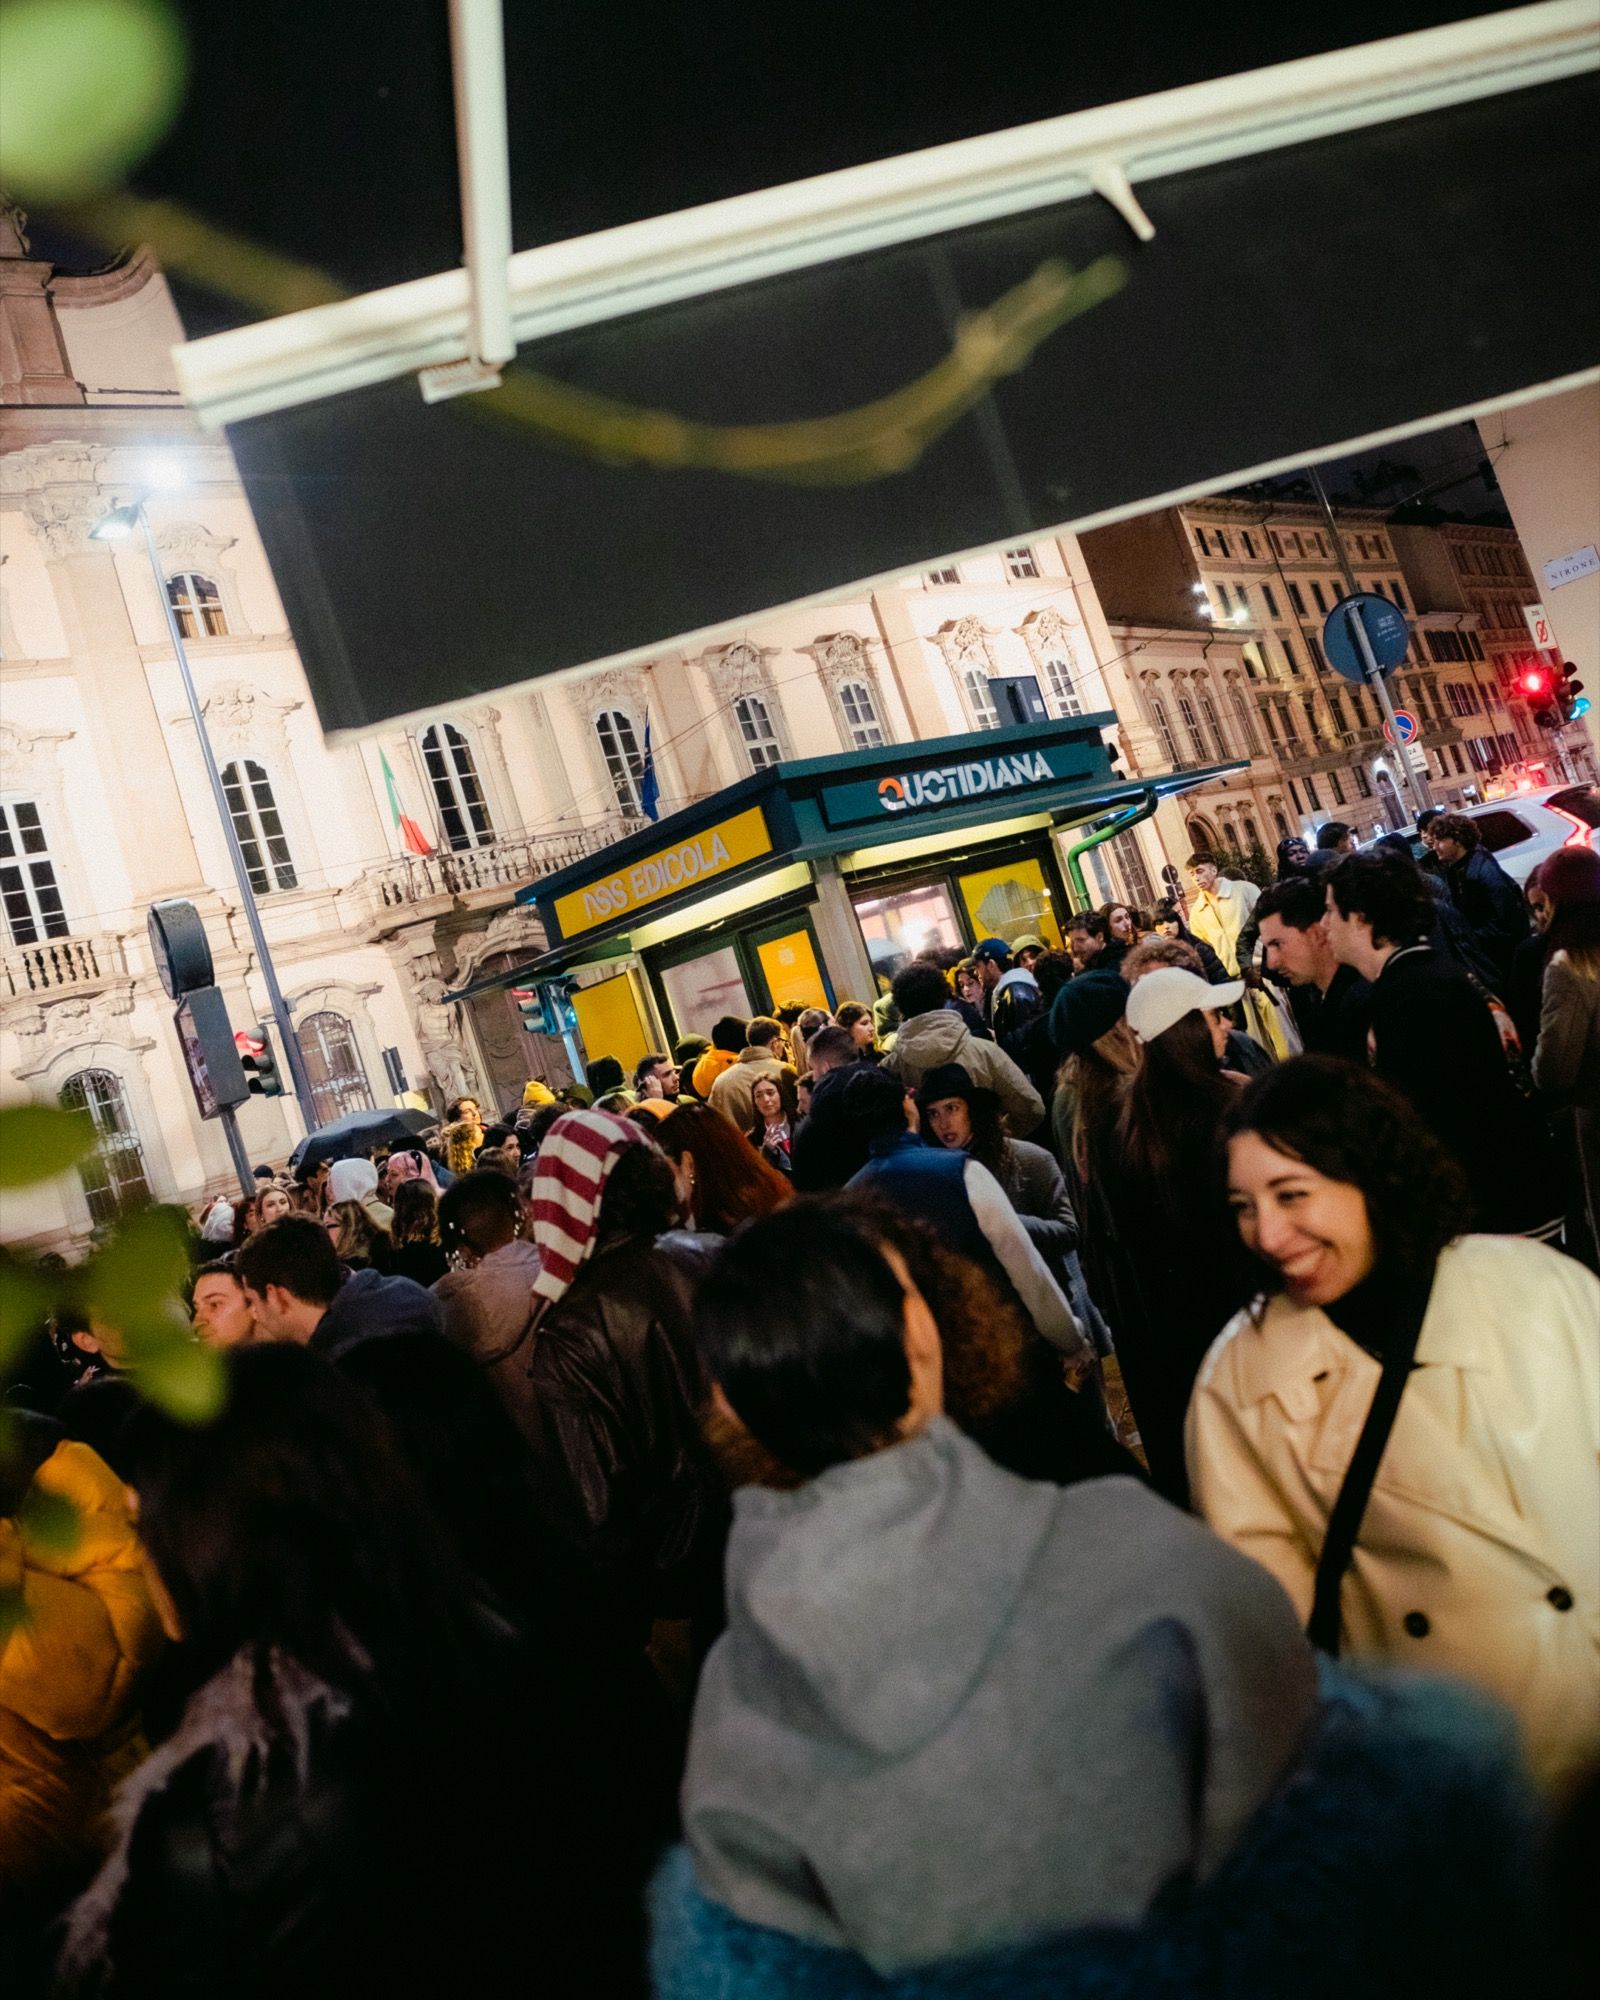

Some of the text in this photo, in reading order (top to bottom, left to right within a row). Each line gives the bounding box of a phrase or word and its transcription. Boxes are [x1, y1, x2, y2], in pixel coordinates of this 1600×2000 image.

[1551, 559, 1594, 580] NIRONE
[878, 750, 1055, 811] QUOTIDIANA
[630, 832, 731, 900] EDICOLA
